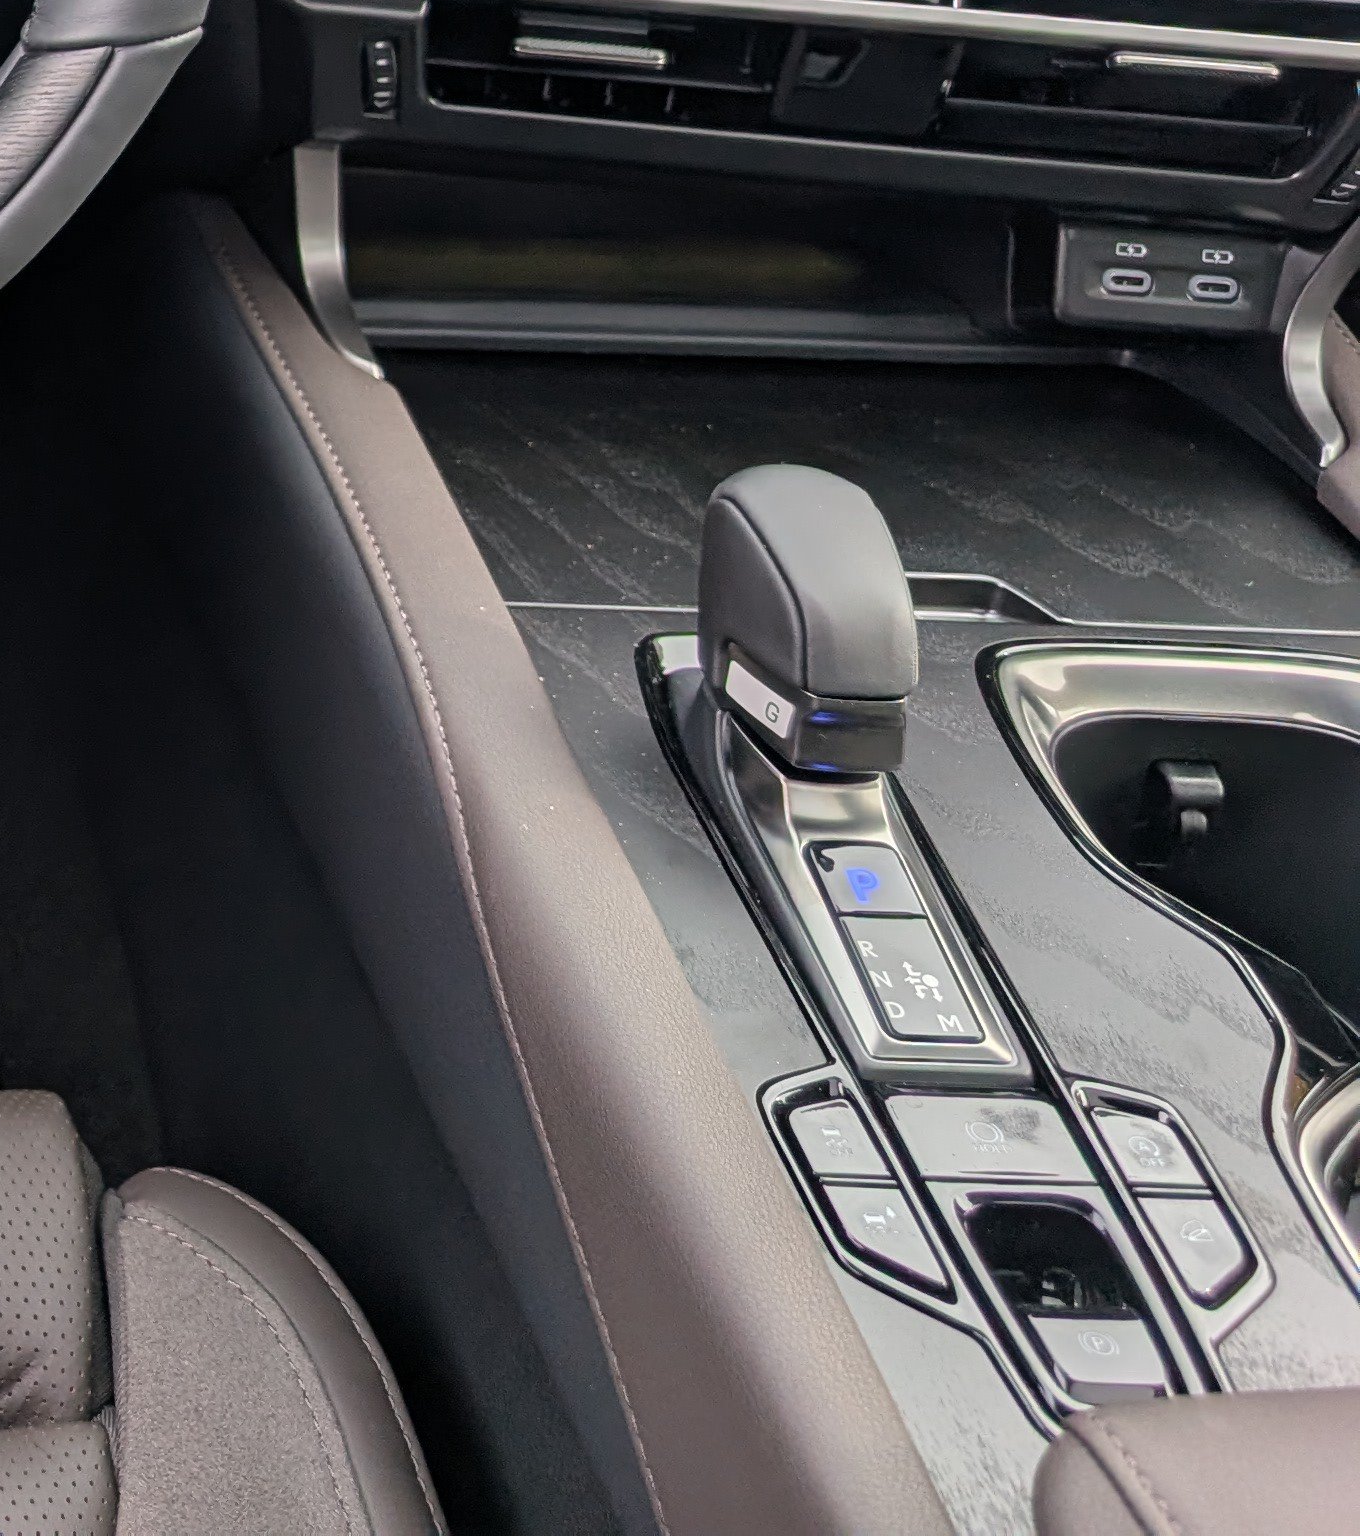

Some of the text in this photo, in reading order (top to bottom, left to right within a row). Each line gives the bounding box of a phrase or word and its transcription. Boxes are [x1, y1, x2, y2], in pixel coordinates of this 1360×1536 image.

[765, 701, 780, 724] G
[844, 867, 880, 904] P
[857, 940, 879, 958] R
[869, 970, 894, 989] N
[884, 1001, 906, 1019] D
[936, 1013, 965, 1033] M
